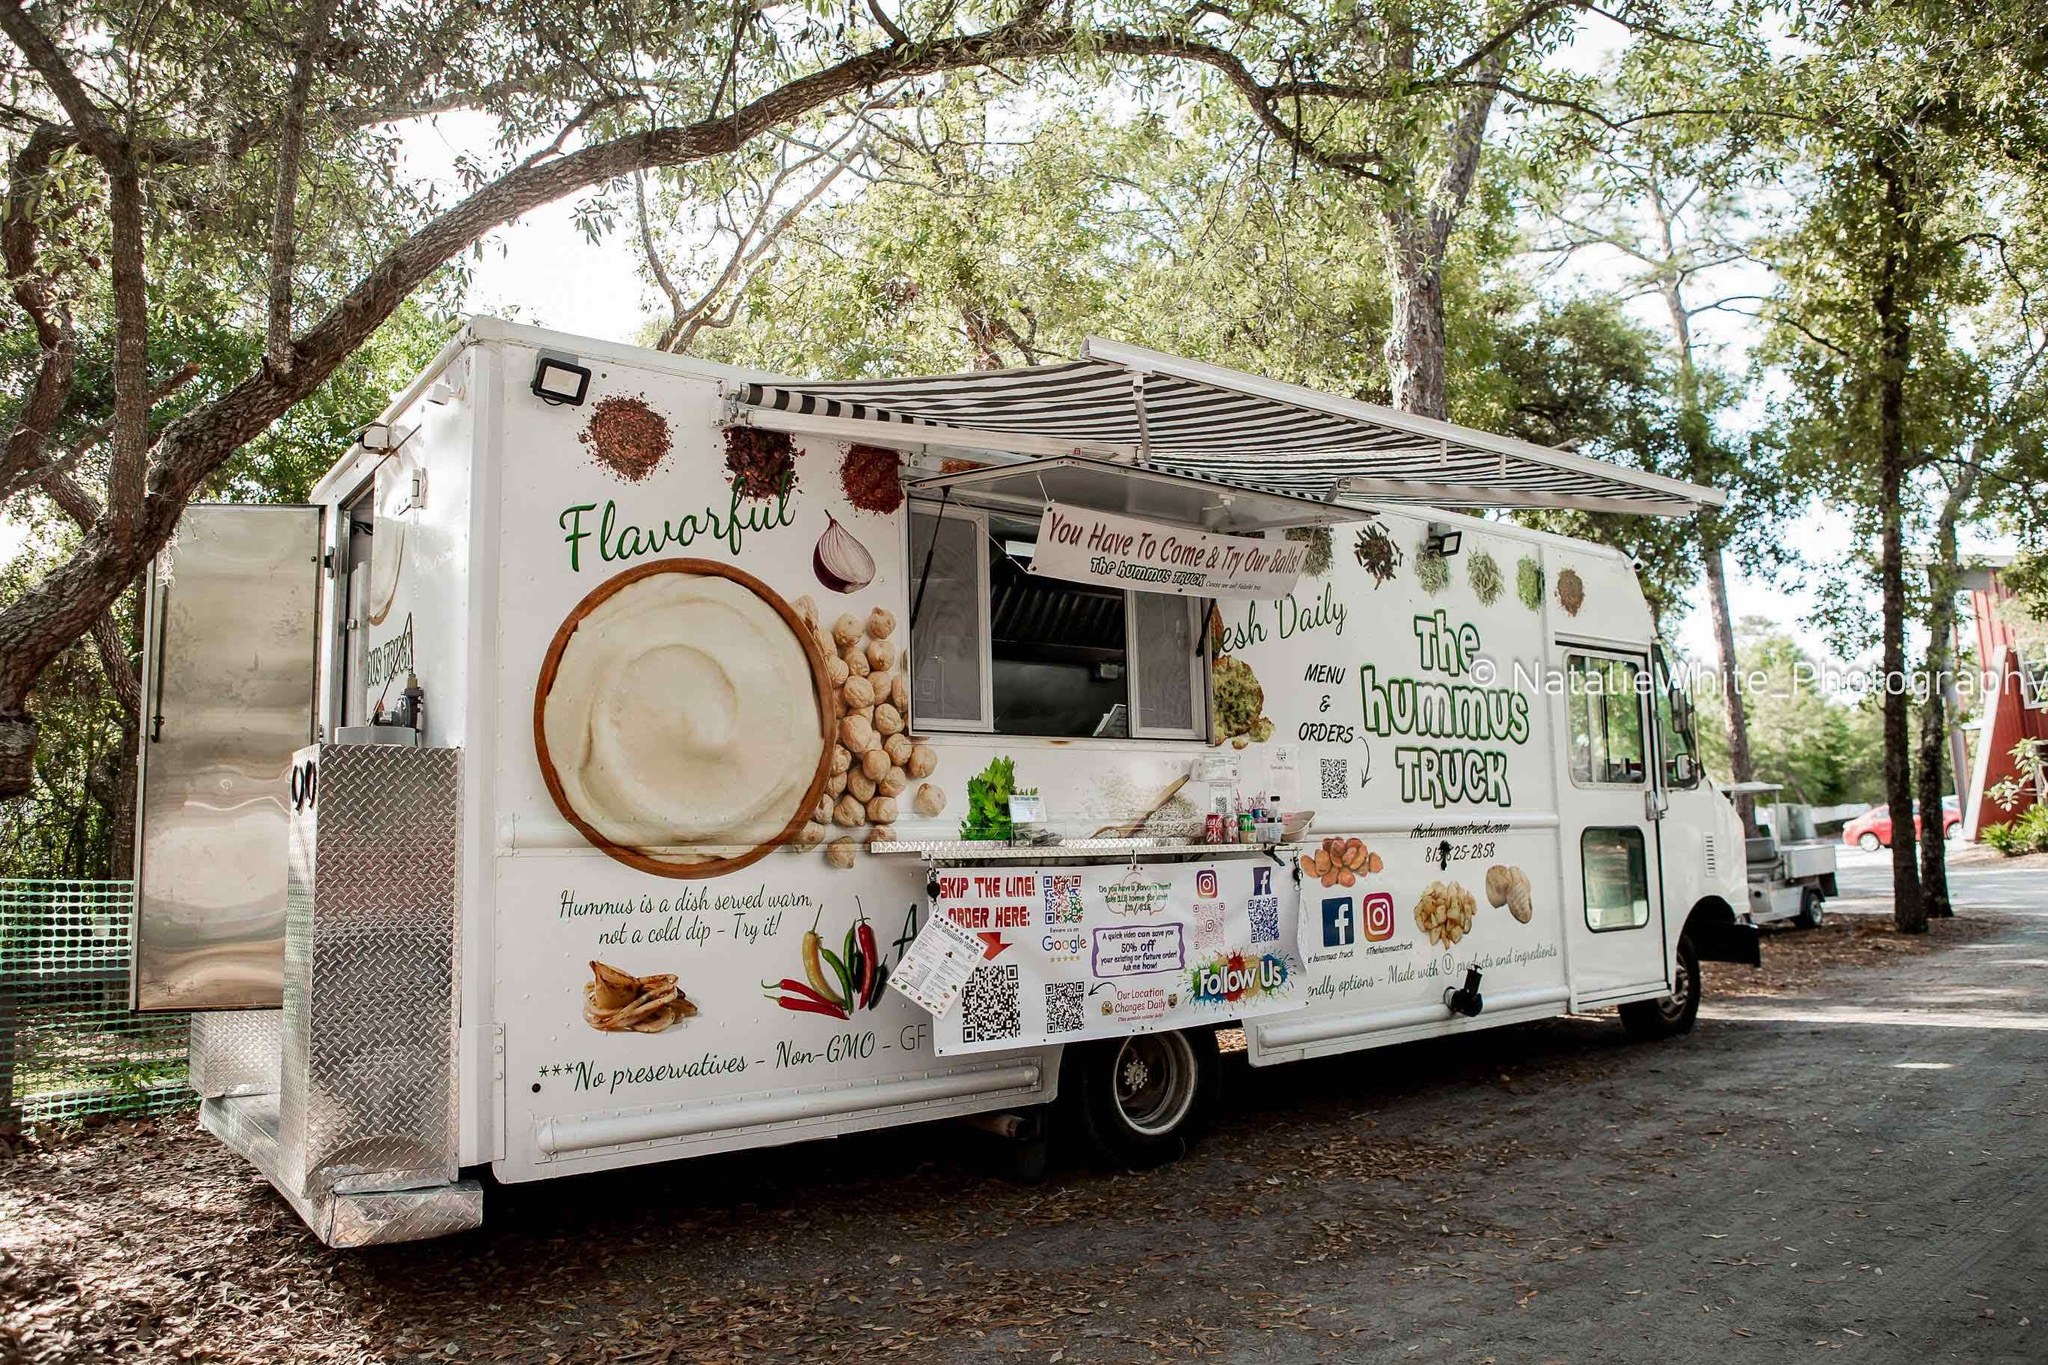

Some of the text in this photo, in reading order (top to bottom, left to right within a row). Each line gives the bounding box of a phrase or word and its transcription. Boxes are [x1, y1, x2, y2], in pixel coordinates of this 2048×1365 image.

[559, 471, 796, 572] Flavorful
[1049, 512, 1303, 579] You Have To Come & Try Our Balls!
[1090, 556, 1117, 576] The
[1171, 571, 1207, 587] TRUCK
[1220, 582, 1347, 652] esh Daily
[1413, 608, 1480, 676] The
[1304, 664, 1346, 684] MENU
[1319, 694, 1331, 712] &
[1298, 722, 1354, 743] ORDERS
[1395, 746, 1511, 808] TRUCK
[1410, 820, 1510, 838] thehummustruck.com
[939, 876, 1036, 899] SKIP THE LINE!
[560, 889, 635, 918] Hummus
[639, 894, 654, 914] is
[659, 898, 670, 913] a
[674, 886, 709, 912] dish
[714, 884, 765, 911] served
[598, 922, 627, 945] not
[631, 928, 643, 943] a
[648, 916, 681, 943] cold
[685, 915, 711, 947] dip
[733, 912, 759, 945] Try
[763, 911, 782, 937] it!
[948, 906, 1030, 929] ORDER HERE:
[1042, 934, 1087, 954] Google
[1108, 931, 1122, 941] quick
[1165, 930, 1174, 938] you
[1121, 939, 1156, 953] 50% off
[1101, 957, 1113, 966] your
[1143, 952, 1161, 960] future
[1142, 962, 1157, 970] how!
[1313, 953, 1337, 963] hummus
[1338, 949, 1353, 959] truck
[1200, 960, 1281, 997] Follow Us
[1338, 974, 1374, 997] options
[1387, 962, 1415, 986] Made
[1417, 958, 1438, 980] with
[1495, 947, 1512, 966] and
[1514, 942, 1558, 966] ingredients
[1117, 988, 1164, 1000] Our Location
[1115, 998, 1166, 1014] Changes Daily
[610, 1052, 748, 1094] preservatives
[776, 1030, 875, 1070] Non-GMO
[900, 1023, 927, 1051] GF
